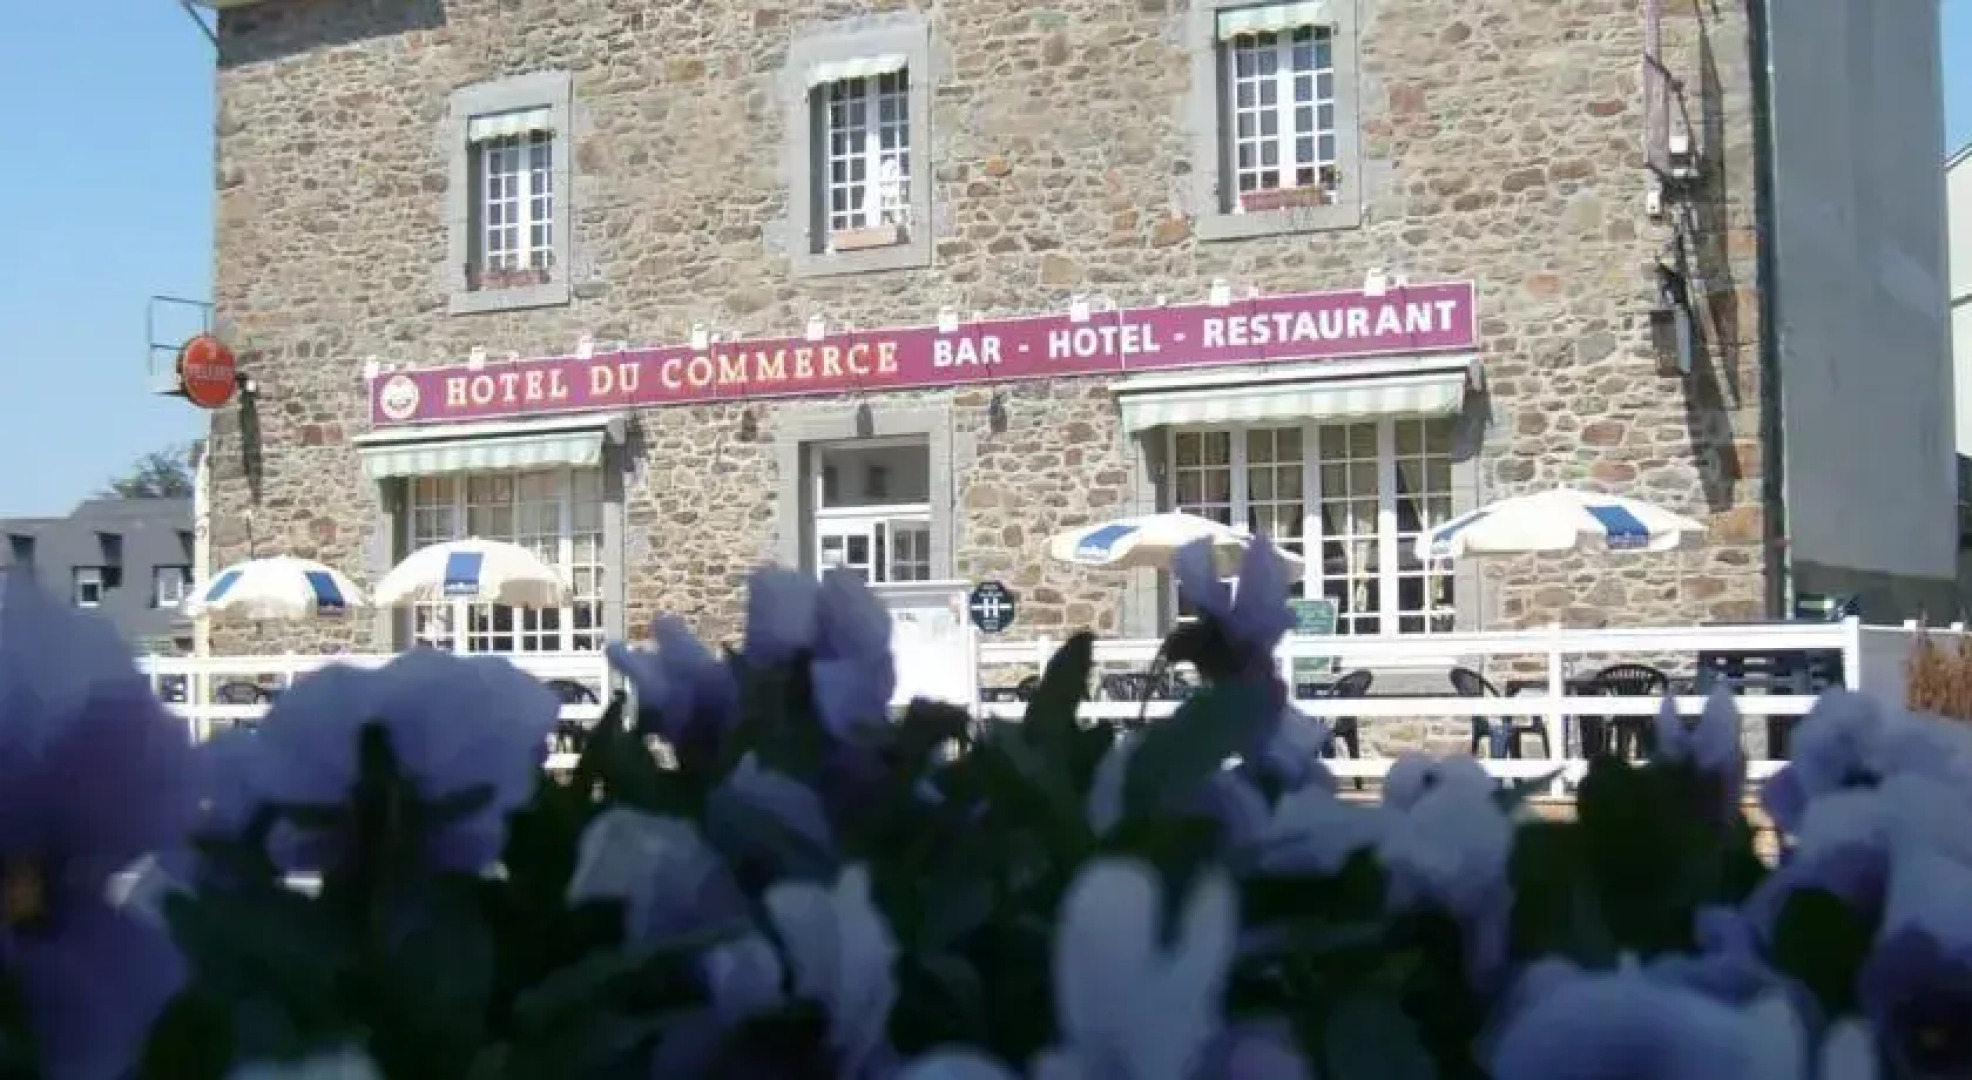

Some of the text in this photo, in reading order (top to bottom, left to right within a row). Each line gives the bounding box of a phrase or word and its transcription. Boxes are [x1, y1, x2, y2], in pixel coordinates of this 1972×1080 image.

[446, 368, 568, 406] HOTEL
[590, 363, 640, 396] DU
[661, 342, 899, 389] COMMERCE
[933, 336, 1002, 367] BAR
[1049, 324, 1161, 358] HOTEL
[1202, 300, 1457, 348] RESTAURANT
